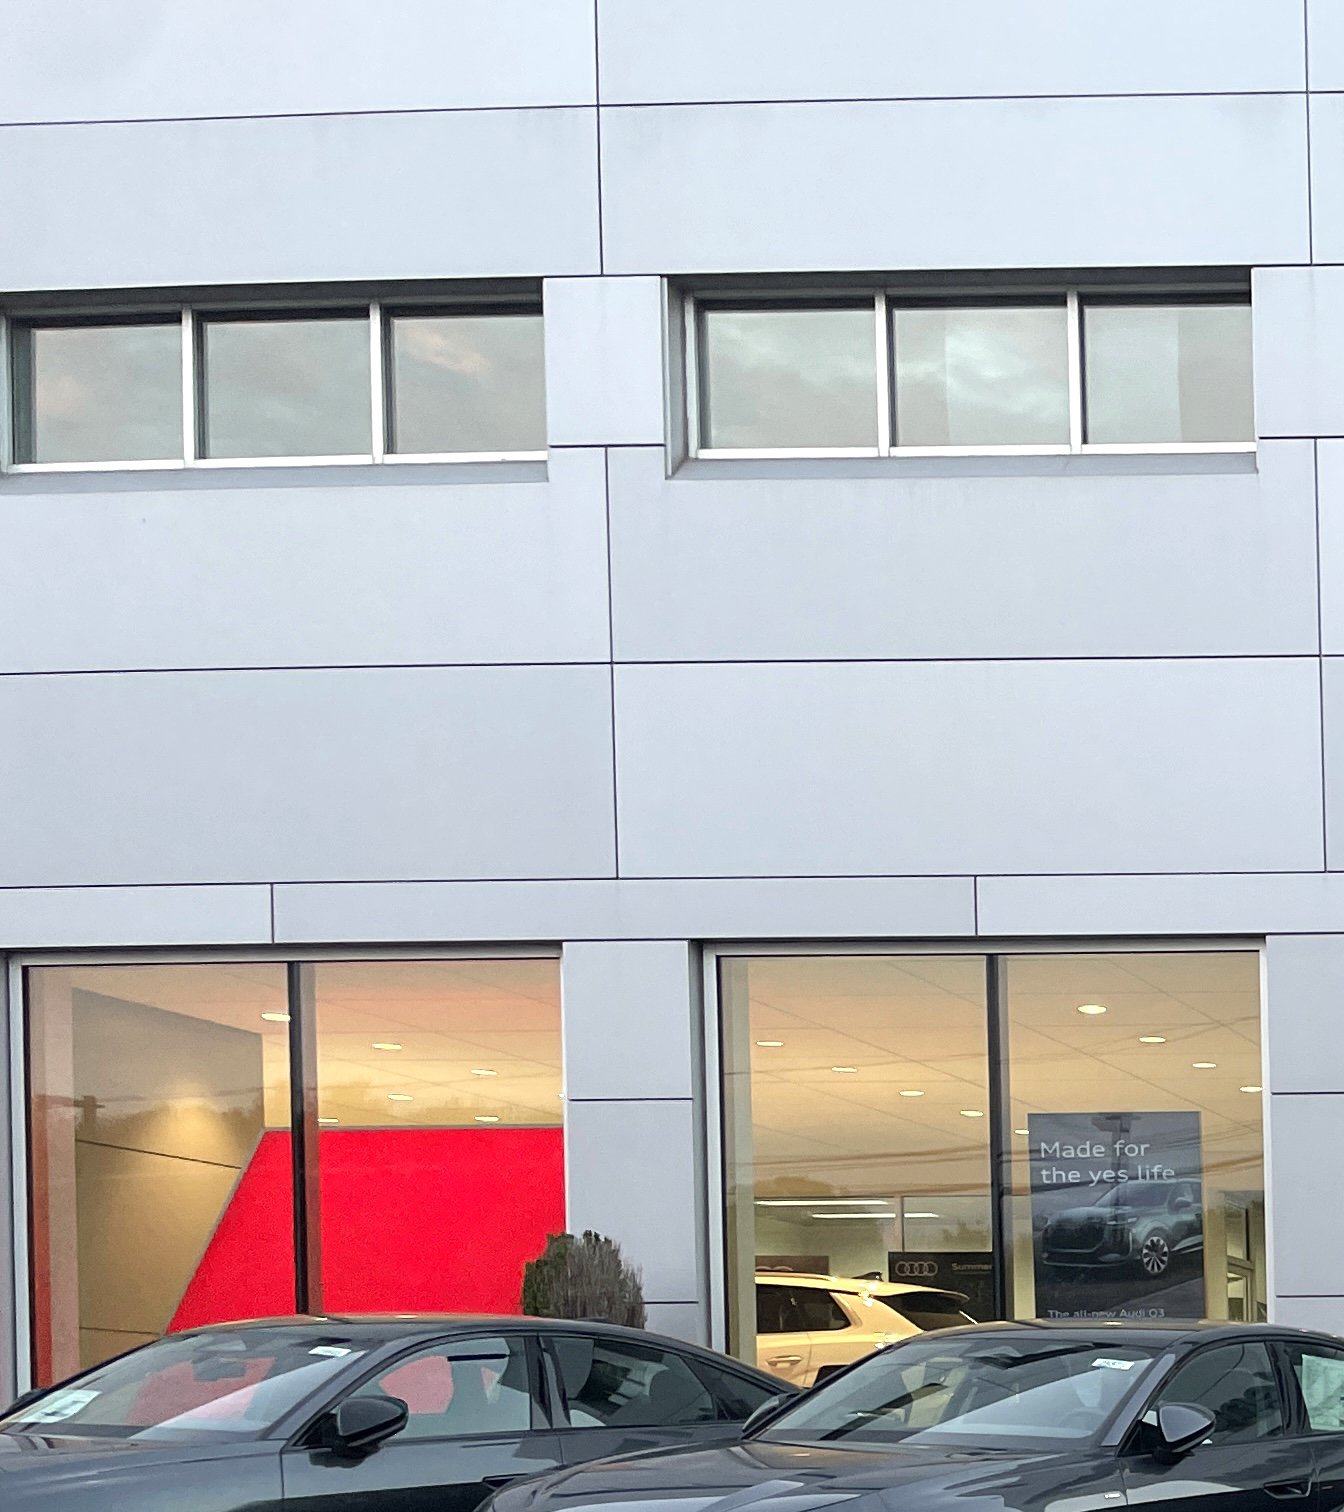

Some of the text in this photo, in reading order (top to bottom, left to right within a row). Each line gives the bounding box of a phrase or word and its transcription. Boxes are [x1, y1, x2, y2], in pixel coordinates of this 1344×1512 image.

[1040, 1140, 1150, 1158] Made for
[1040, 1164, 1175, 1187] the yes life
[1047, 1309, 1070, 1318] The
[1119, 1308, 1145, 1318] Audi
